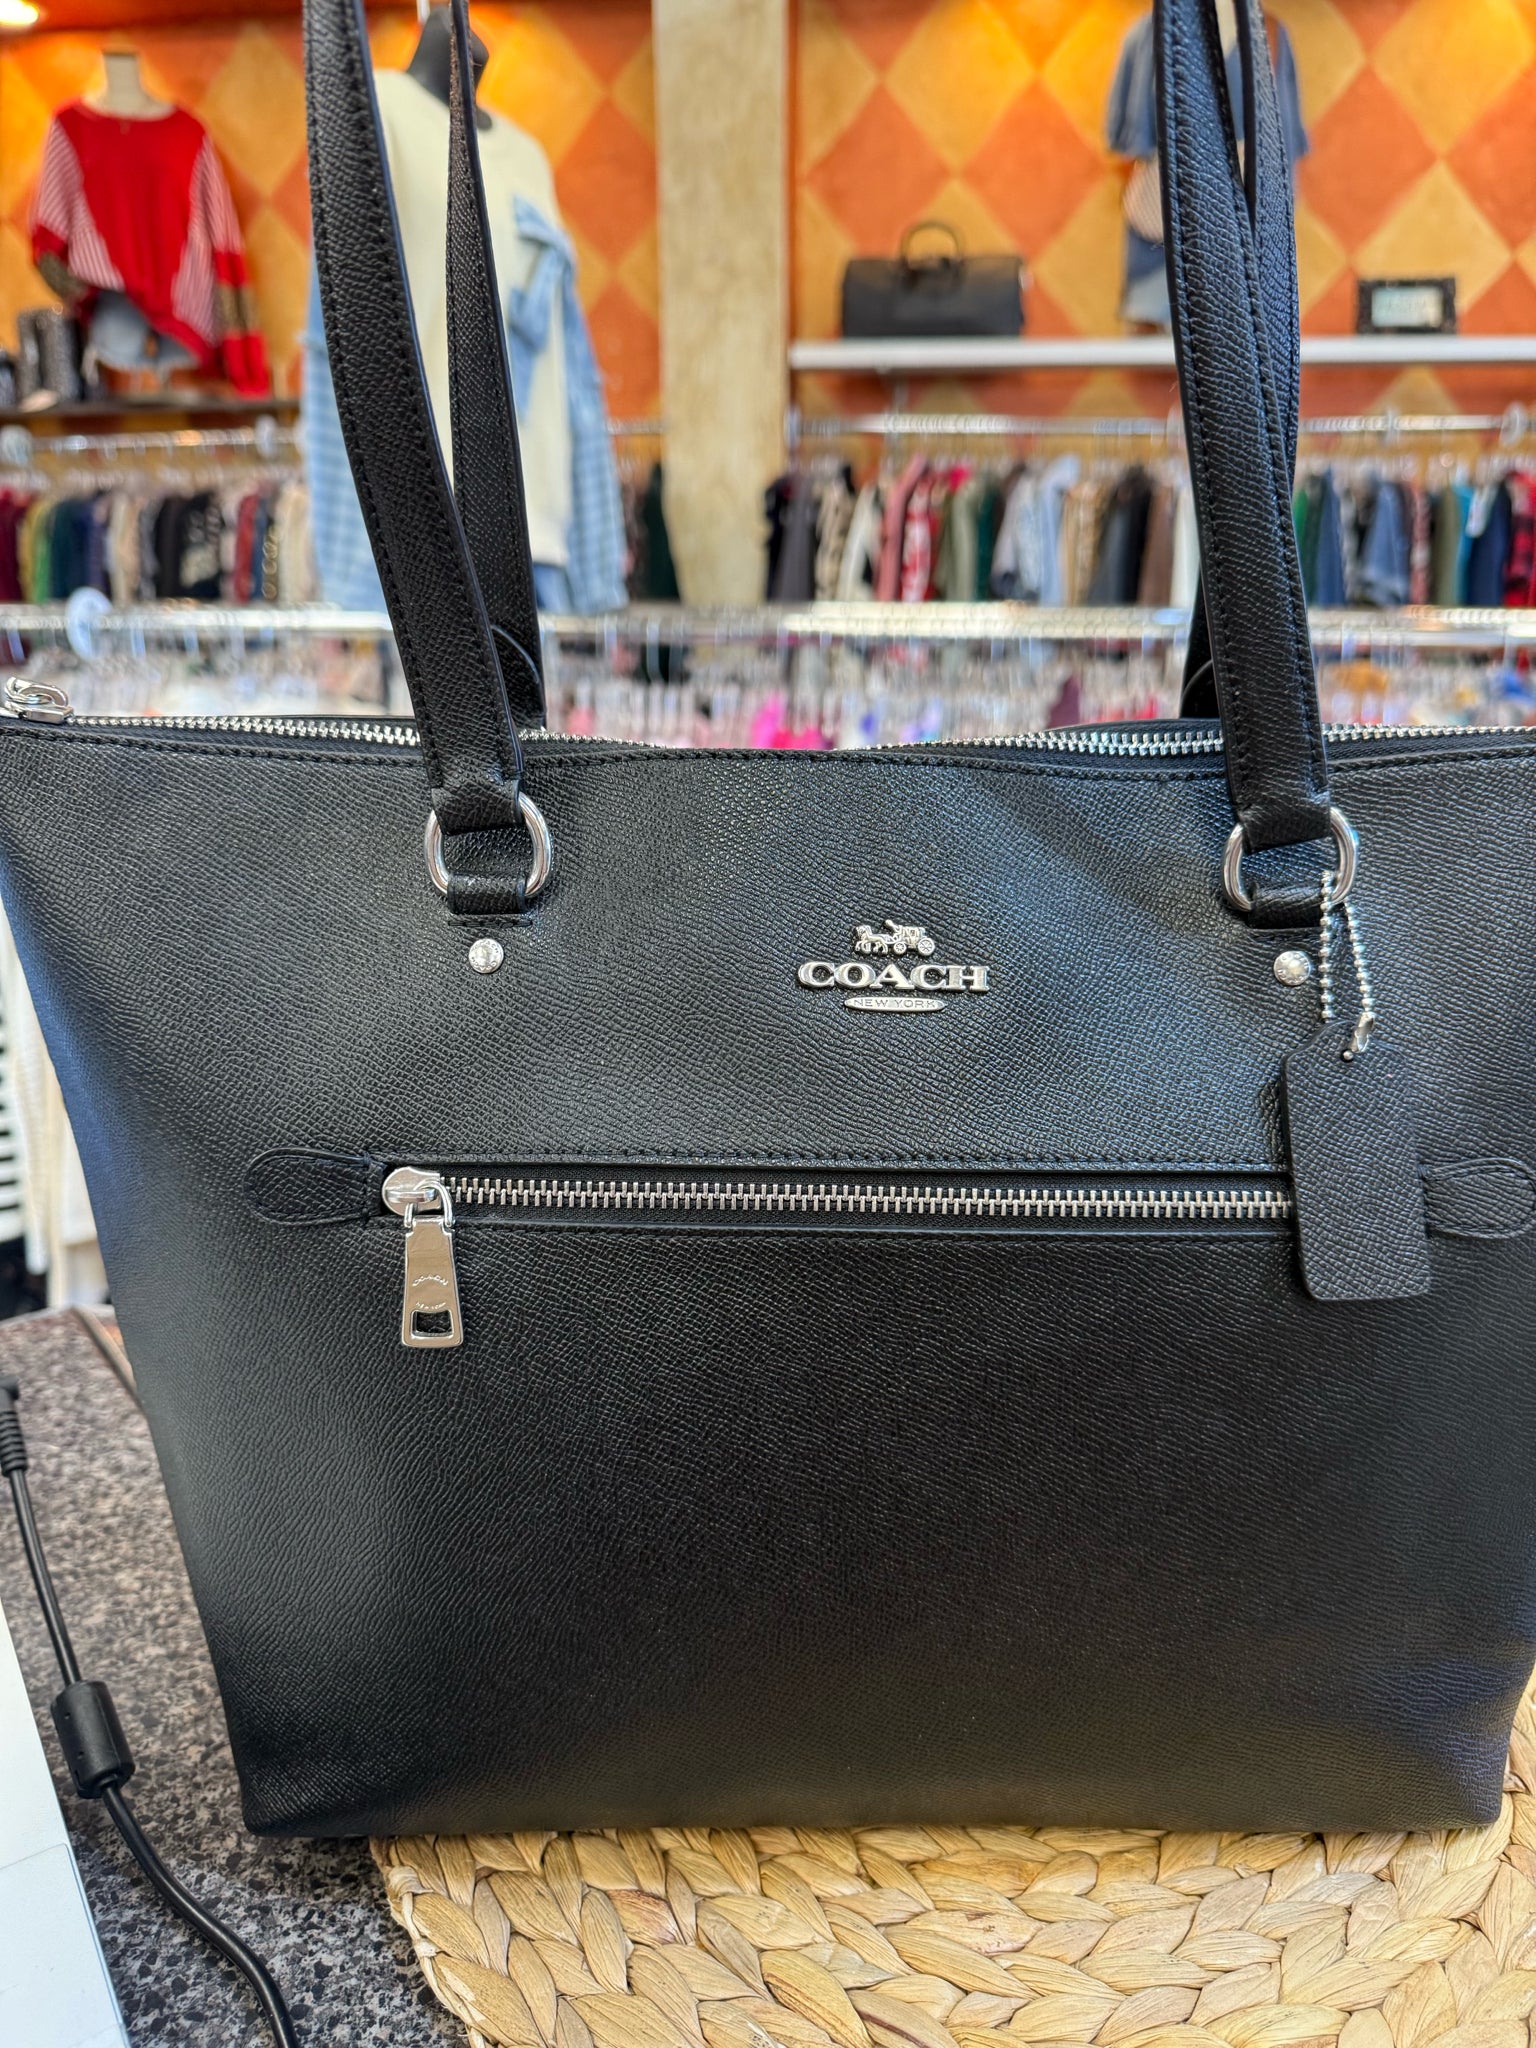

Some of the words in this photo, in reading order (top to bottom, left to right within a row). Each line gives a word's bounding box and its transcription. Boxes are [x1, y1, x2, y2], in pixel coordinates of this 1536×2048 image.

[798, 961, 990, 992] COACH
[853, 998, 889, 1008] NEW
[894, 999, 935, 1009] YORK
